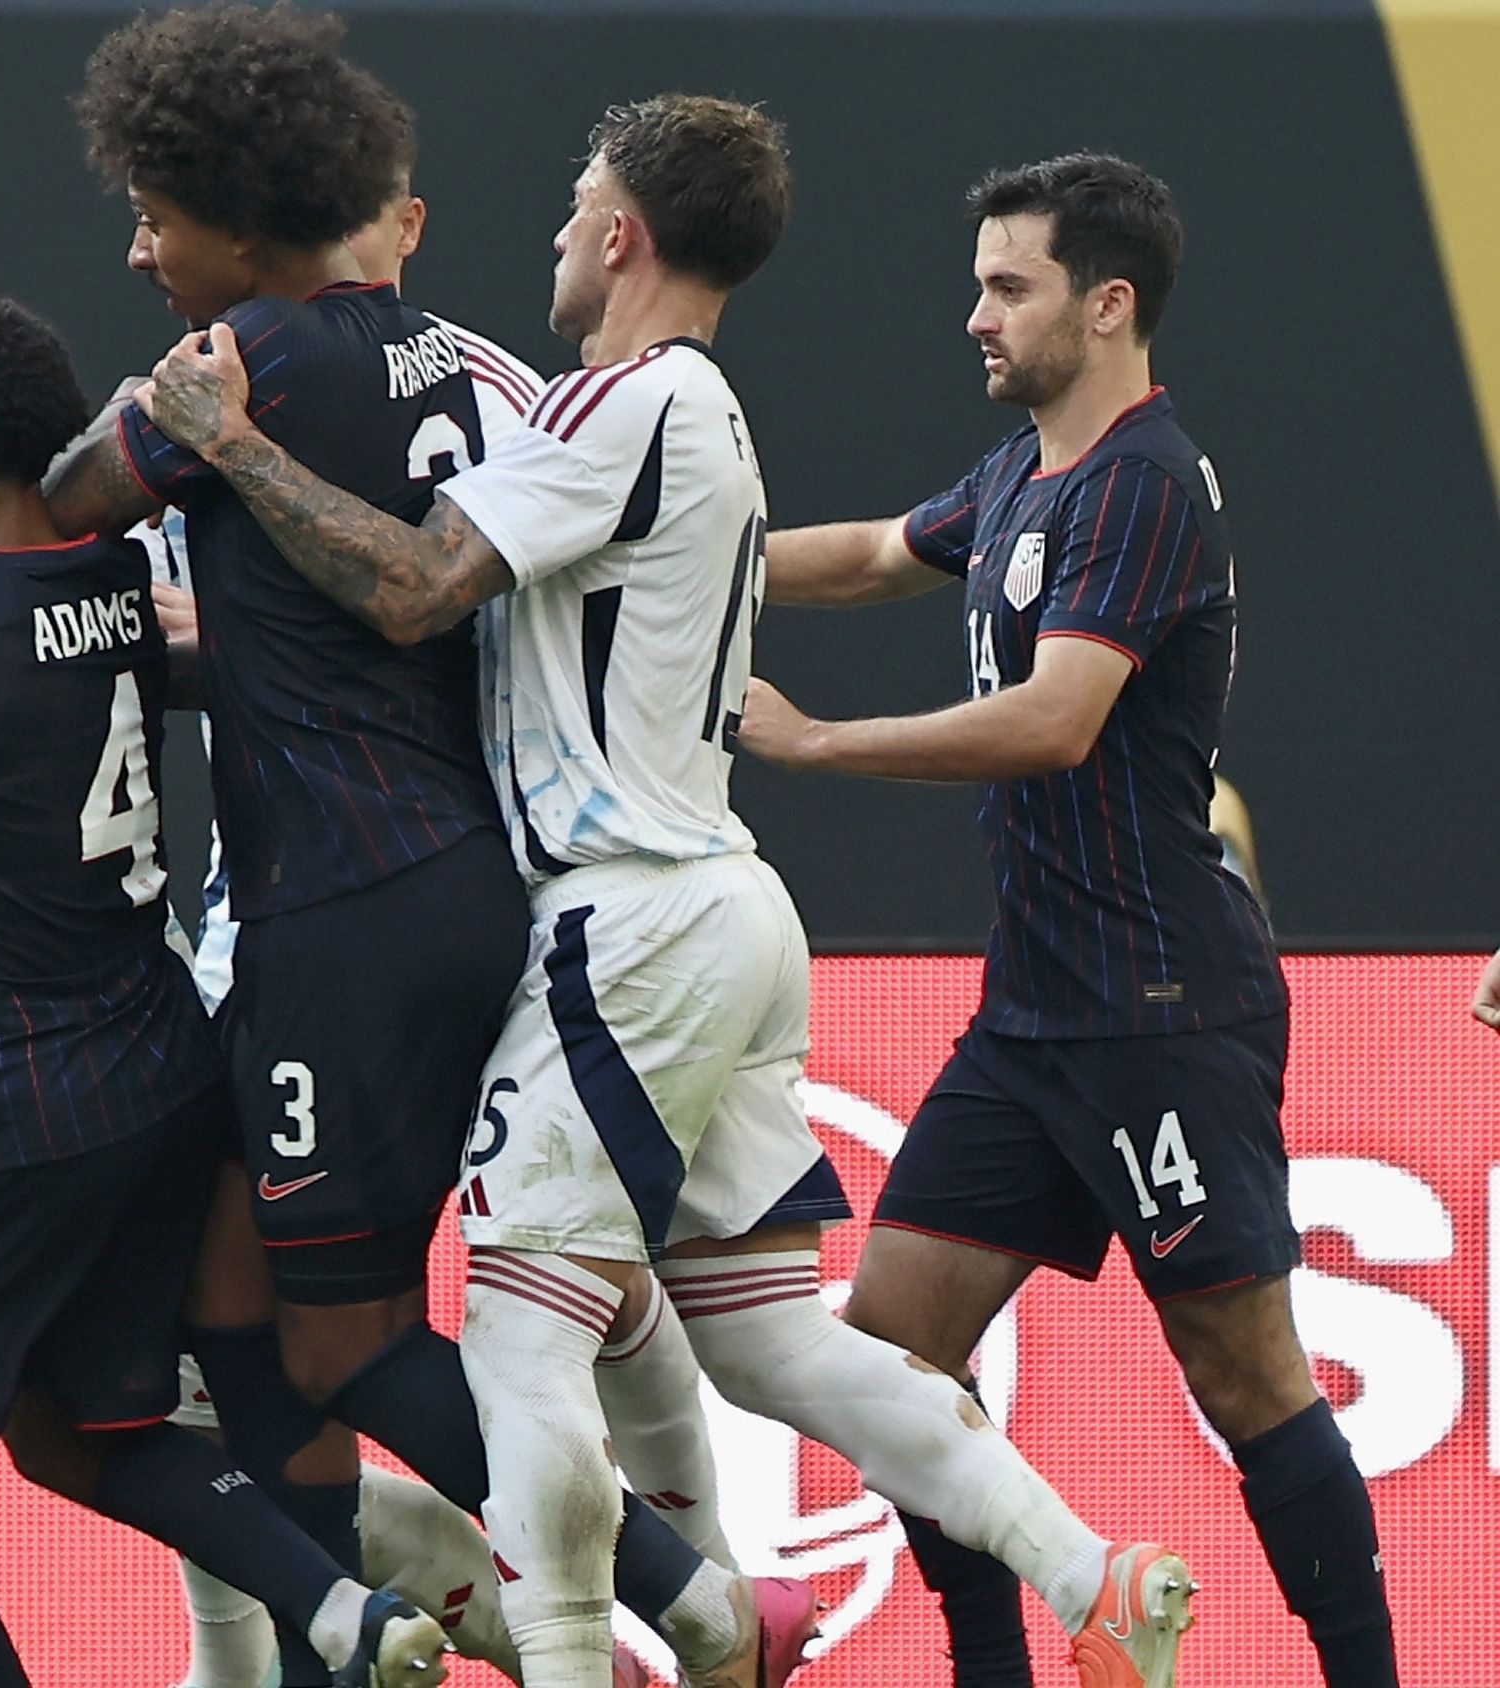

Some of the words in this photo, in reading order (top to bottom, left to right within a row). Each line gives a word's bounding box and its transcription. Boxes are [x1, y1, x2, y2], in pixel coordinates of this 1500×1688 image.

[33, 588, 142, 662] ADAMS
[967, 608, 1001, 700] 14
[79, 670, 168, 908] 4
[270, 1061, 317, 1157] 3
[1112, 1110, 1208, 1219] 14
[210, 1470, 255, 1494] USA
